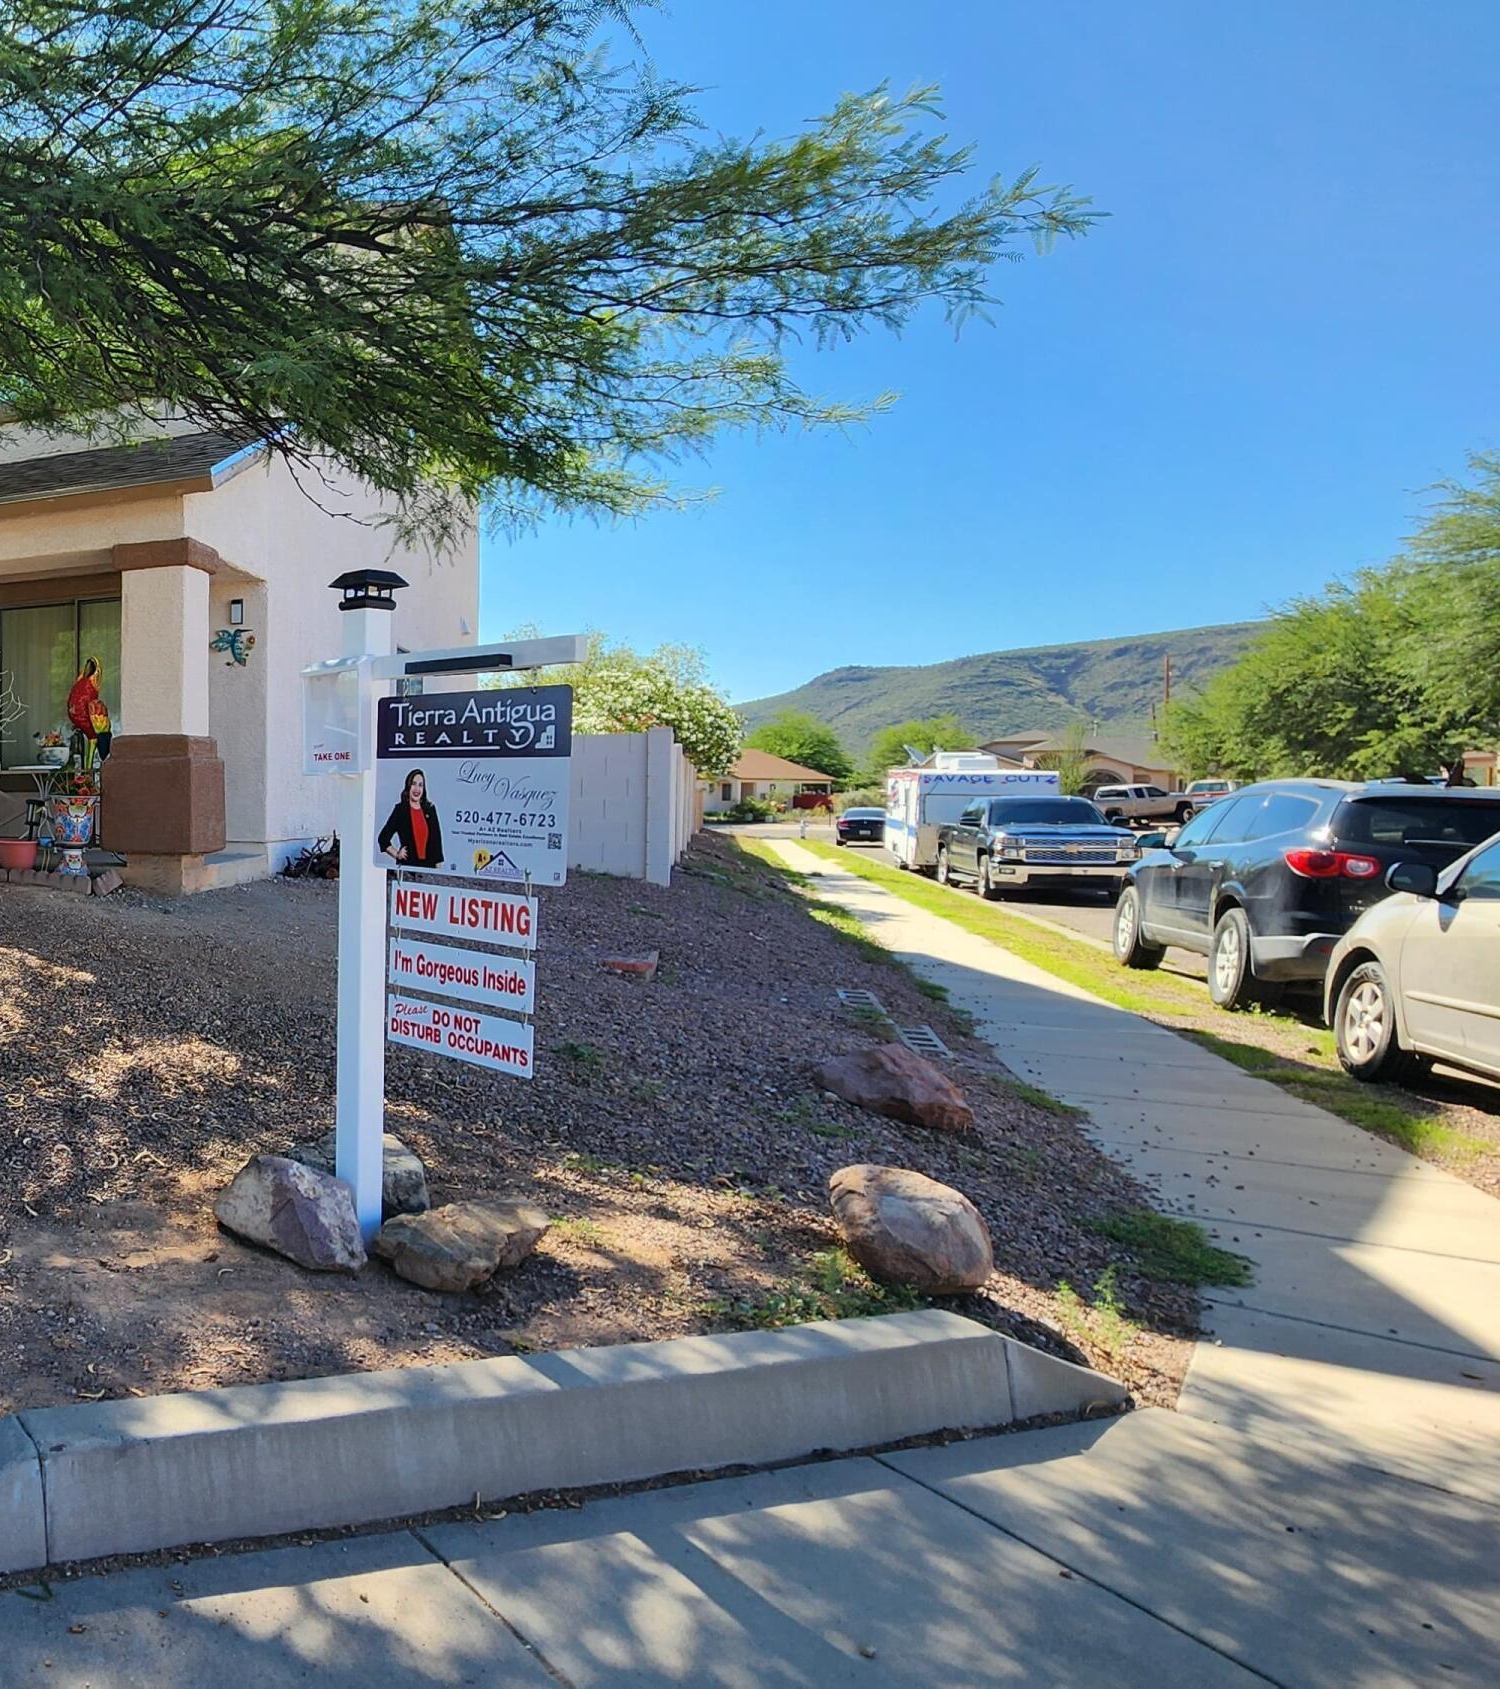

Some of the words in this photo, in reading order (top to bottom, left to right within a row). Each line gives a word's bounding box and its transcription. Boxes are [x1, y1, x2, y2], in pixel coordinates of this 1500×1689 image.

[389, 702, 456, 727] Tierra
[460, 698, 556, 739] Antigua
[394, 729, 526, 745] REALTY
[313, 753, 333, 761] TAKE
[334, 751, 351, 760] ONE
[457, 760, 496, 792] Lucy
[493, 776, 558, 810] Vasquez
[923, 774, 995, 784] SAVAGE
[1003, 775, 1059, 785] CUTZ
[455, 811, 556, 828] 520-477-6723
[395, 889, 438, 921] NEW
[449, 896, 531, 936] LISTING
[394, 950, 412, 973] I'm
[416, 954, 479, 987] Gorgeous
[482, 966, 526, 996] Inside
[394, 1003, 428, 1016] Please
[432, 1010, 450, 1028] DO
[454, 1014, 481, 1035] NOT
[391, 1018, 441, 1043] DISTURB
[447, 1032, 528, 1067] OCCUPANTS
